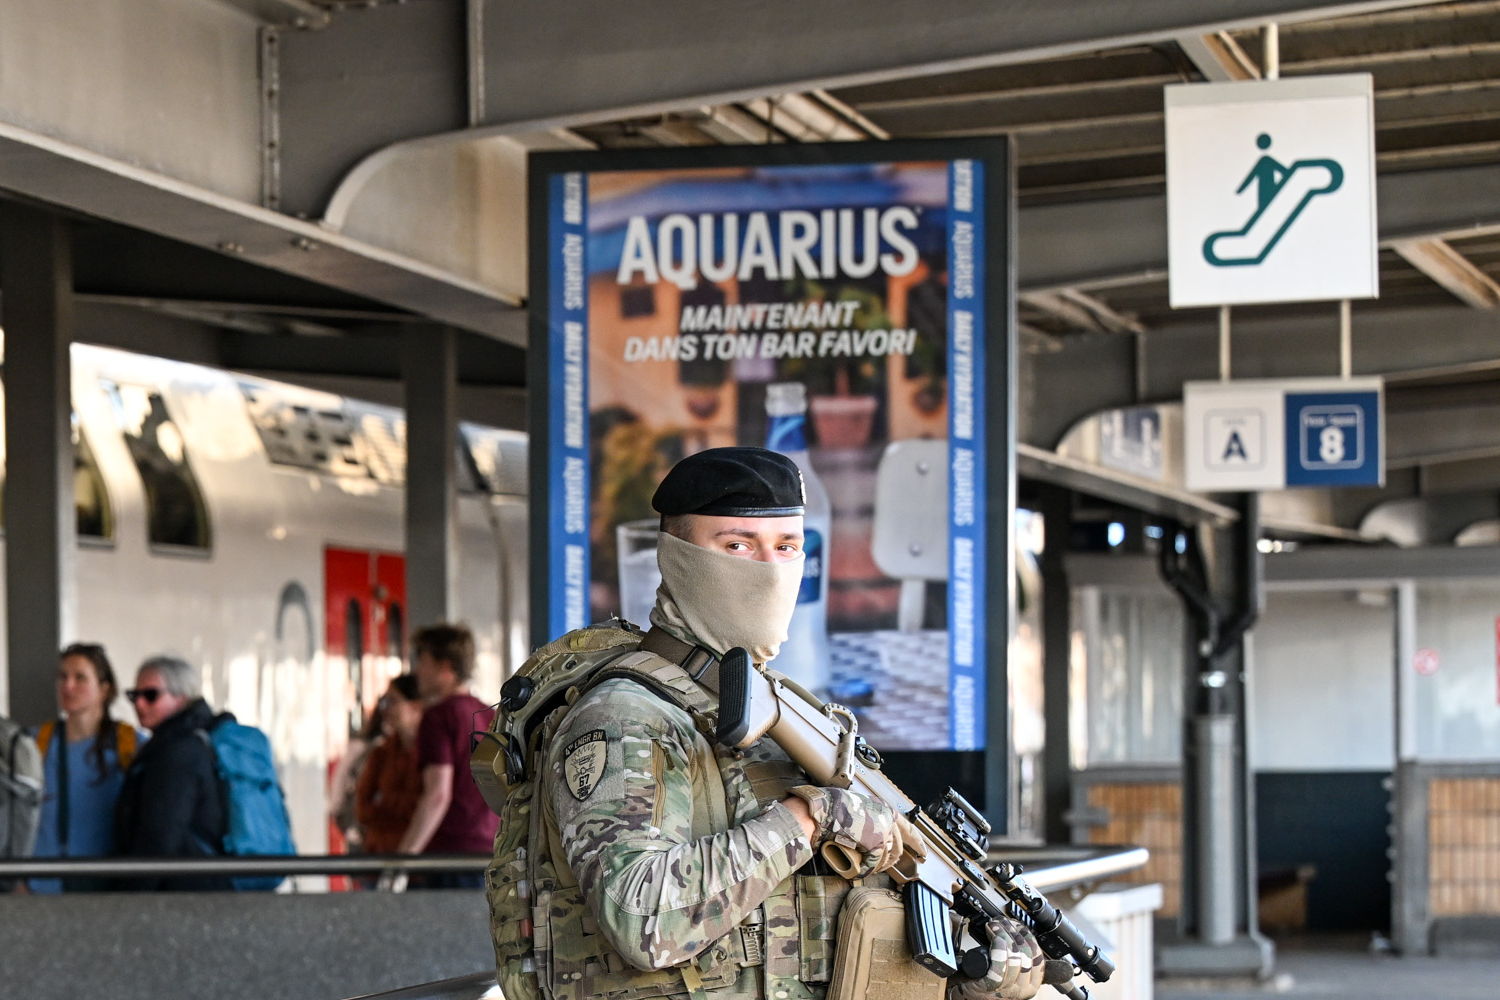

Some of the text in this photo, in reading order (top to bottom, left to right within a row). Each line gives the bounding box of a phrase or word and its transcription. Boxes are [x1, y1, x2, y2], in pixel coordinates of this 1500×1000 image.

[562, 233, 584, 310] AQUARIUS
[616, 206, 920, 290] AQUARIUS
[952, 221, 974, 299] AQUARIUS
[624, 328, 918, 361] DANS TON BAR FAVORI
[680, 301, 859, 331] MAINTENANT
[1223, 429, 1247, 461] A
[1319, 426, 1345, 464] 8
[563, 456, 585, 534] AQUARIUS
[953, 447, 975, 526] AQUARIUS
[579, 774, 590, 787] 67
